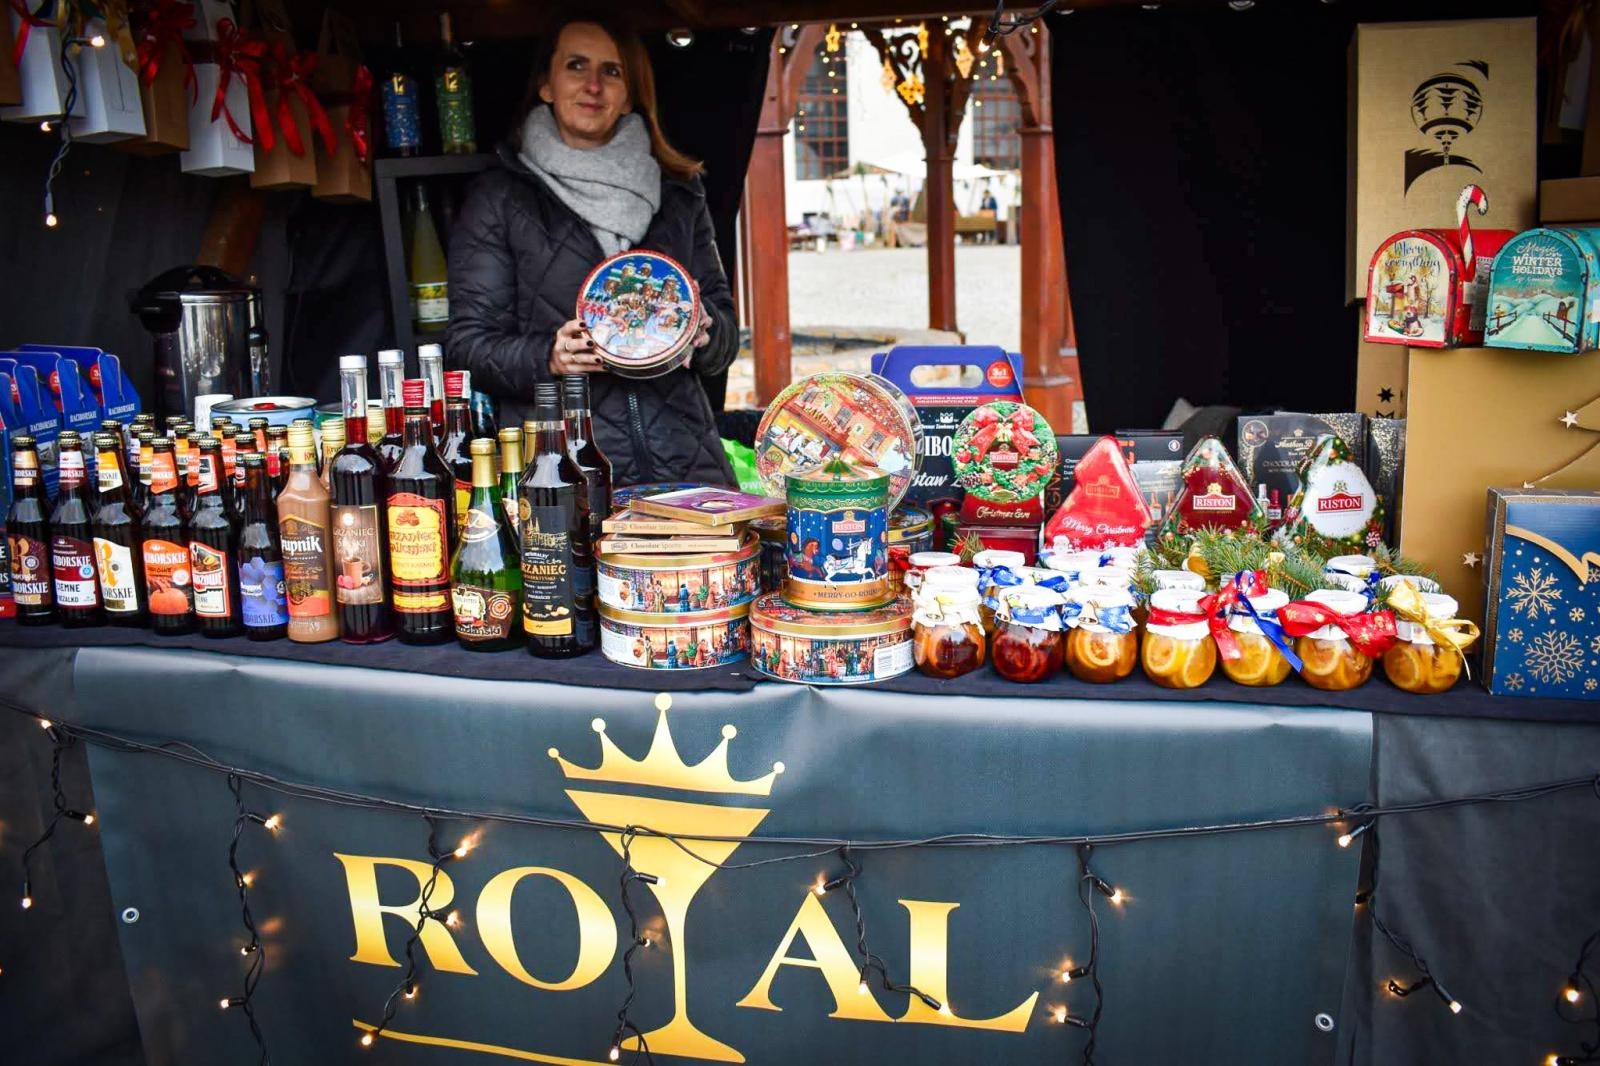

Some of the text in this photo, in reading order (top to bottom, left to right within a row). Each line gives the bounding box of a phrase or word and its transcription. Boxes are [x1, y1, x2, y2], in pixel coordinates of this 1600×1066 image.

[1513, 255, 1562, 267] WINTER
[1512, 265, 1563, 278] HOLIDAYS
[1196, 499, 1232, 507] RISTON
[1320, 498, 1361, 510] RISTON
[1062, 516, 1137, 535] Merry Christmas
[334, 790, 1040, 1063] ROYAL
